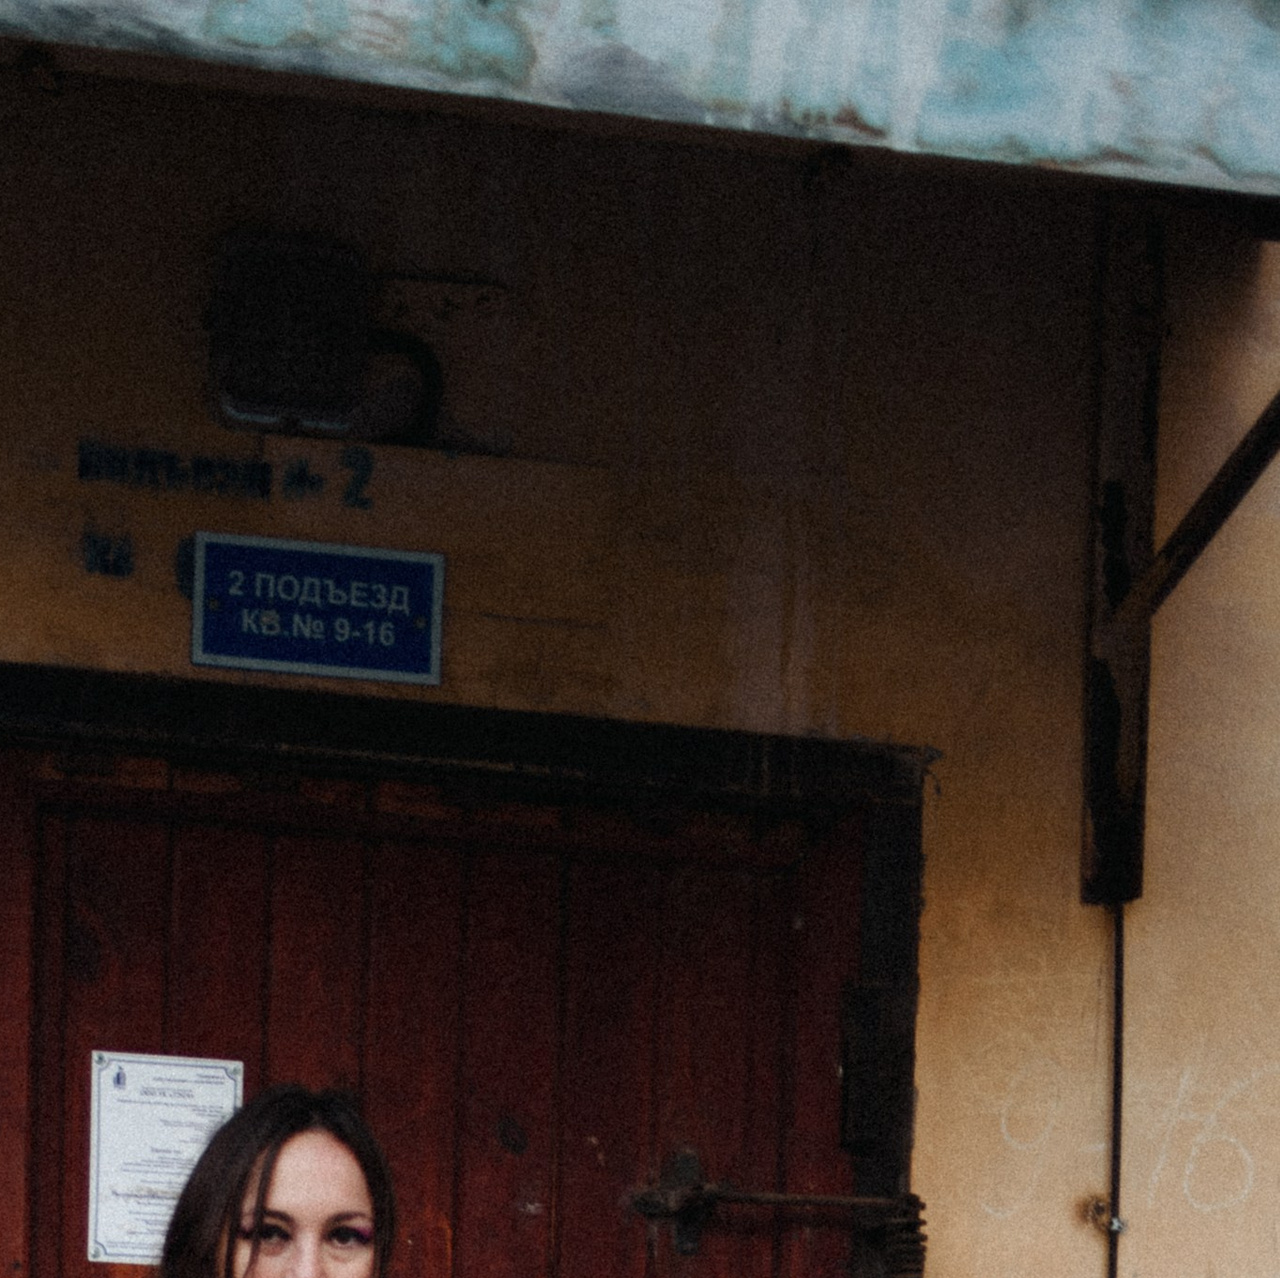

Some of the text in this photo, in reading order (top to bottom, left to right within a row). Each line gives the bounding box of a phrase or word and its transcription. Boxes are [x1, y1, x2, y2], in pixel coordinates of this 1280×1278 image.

[340, 444, 375, 511] 2
[228, 570, 411, 617] 2 ПОДЪЕЗД
[334, 617, 396, 647] 9-16
